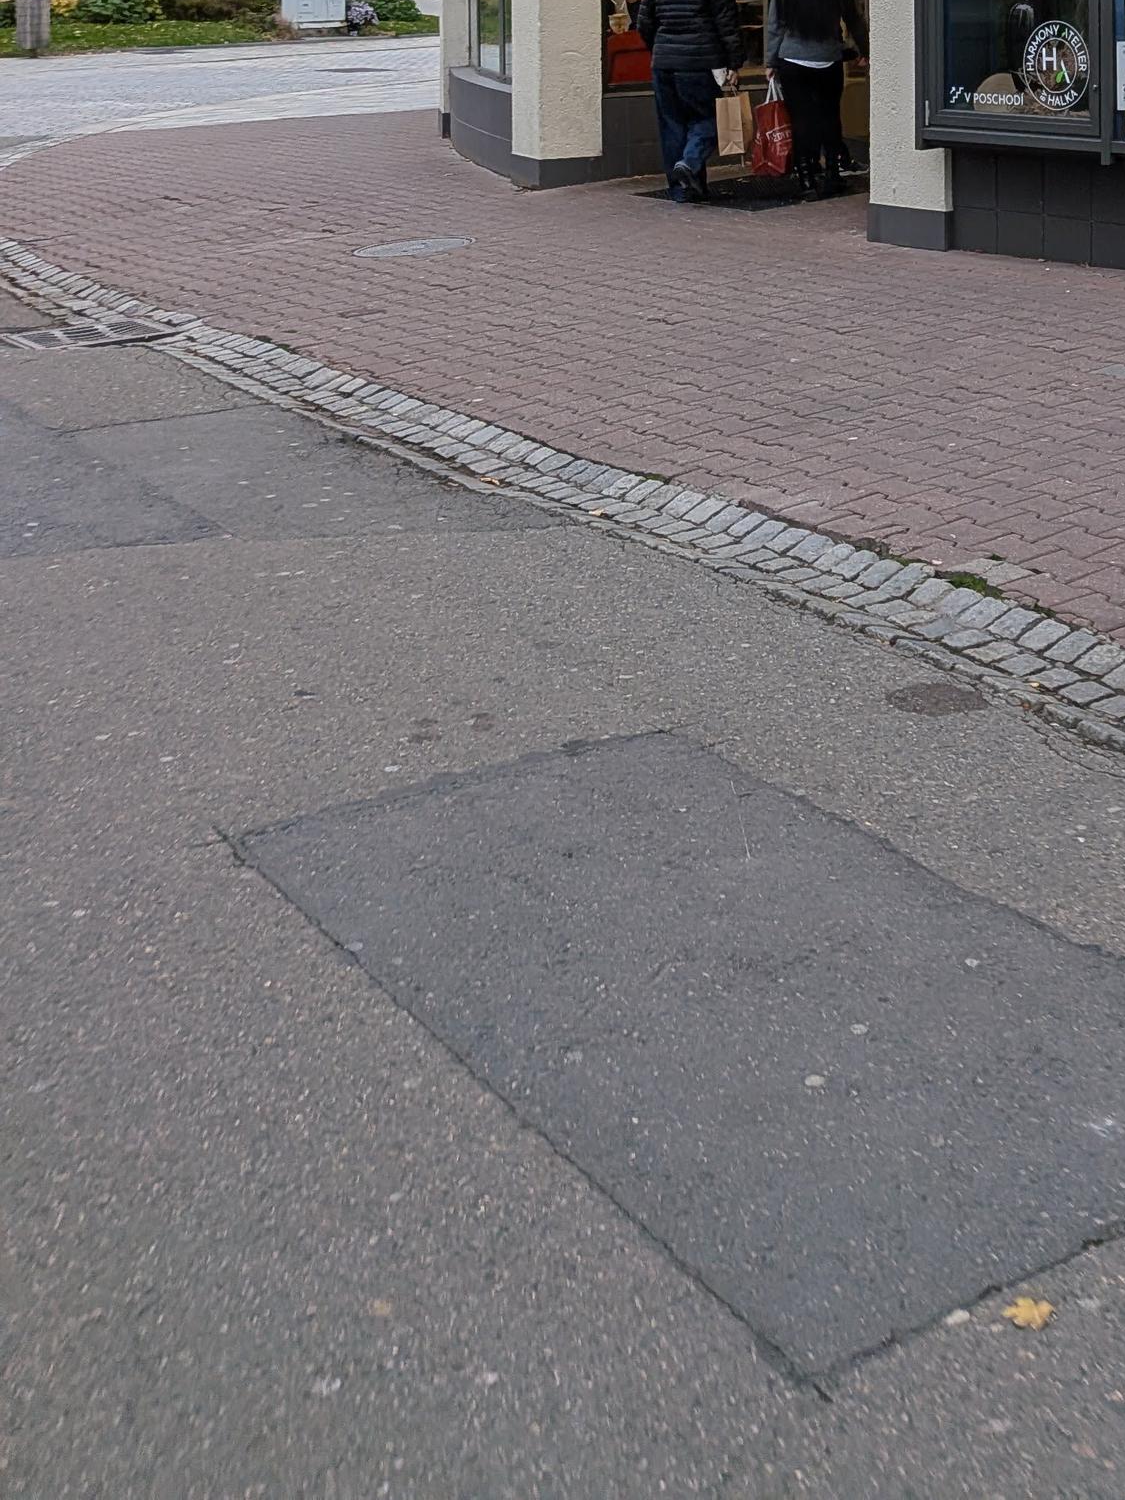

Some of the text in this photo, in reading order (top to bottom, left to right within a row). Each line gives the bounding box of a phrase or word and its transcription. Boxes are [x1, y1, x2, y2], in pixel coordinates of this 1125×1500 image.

[1026, 24, 1060, 72] HARMONY
[964, 92, 1024, 105] V POSCHODÍ
[1047, 89, 1079, 107] HALKA
